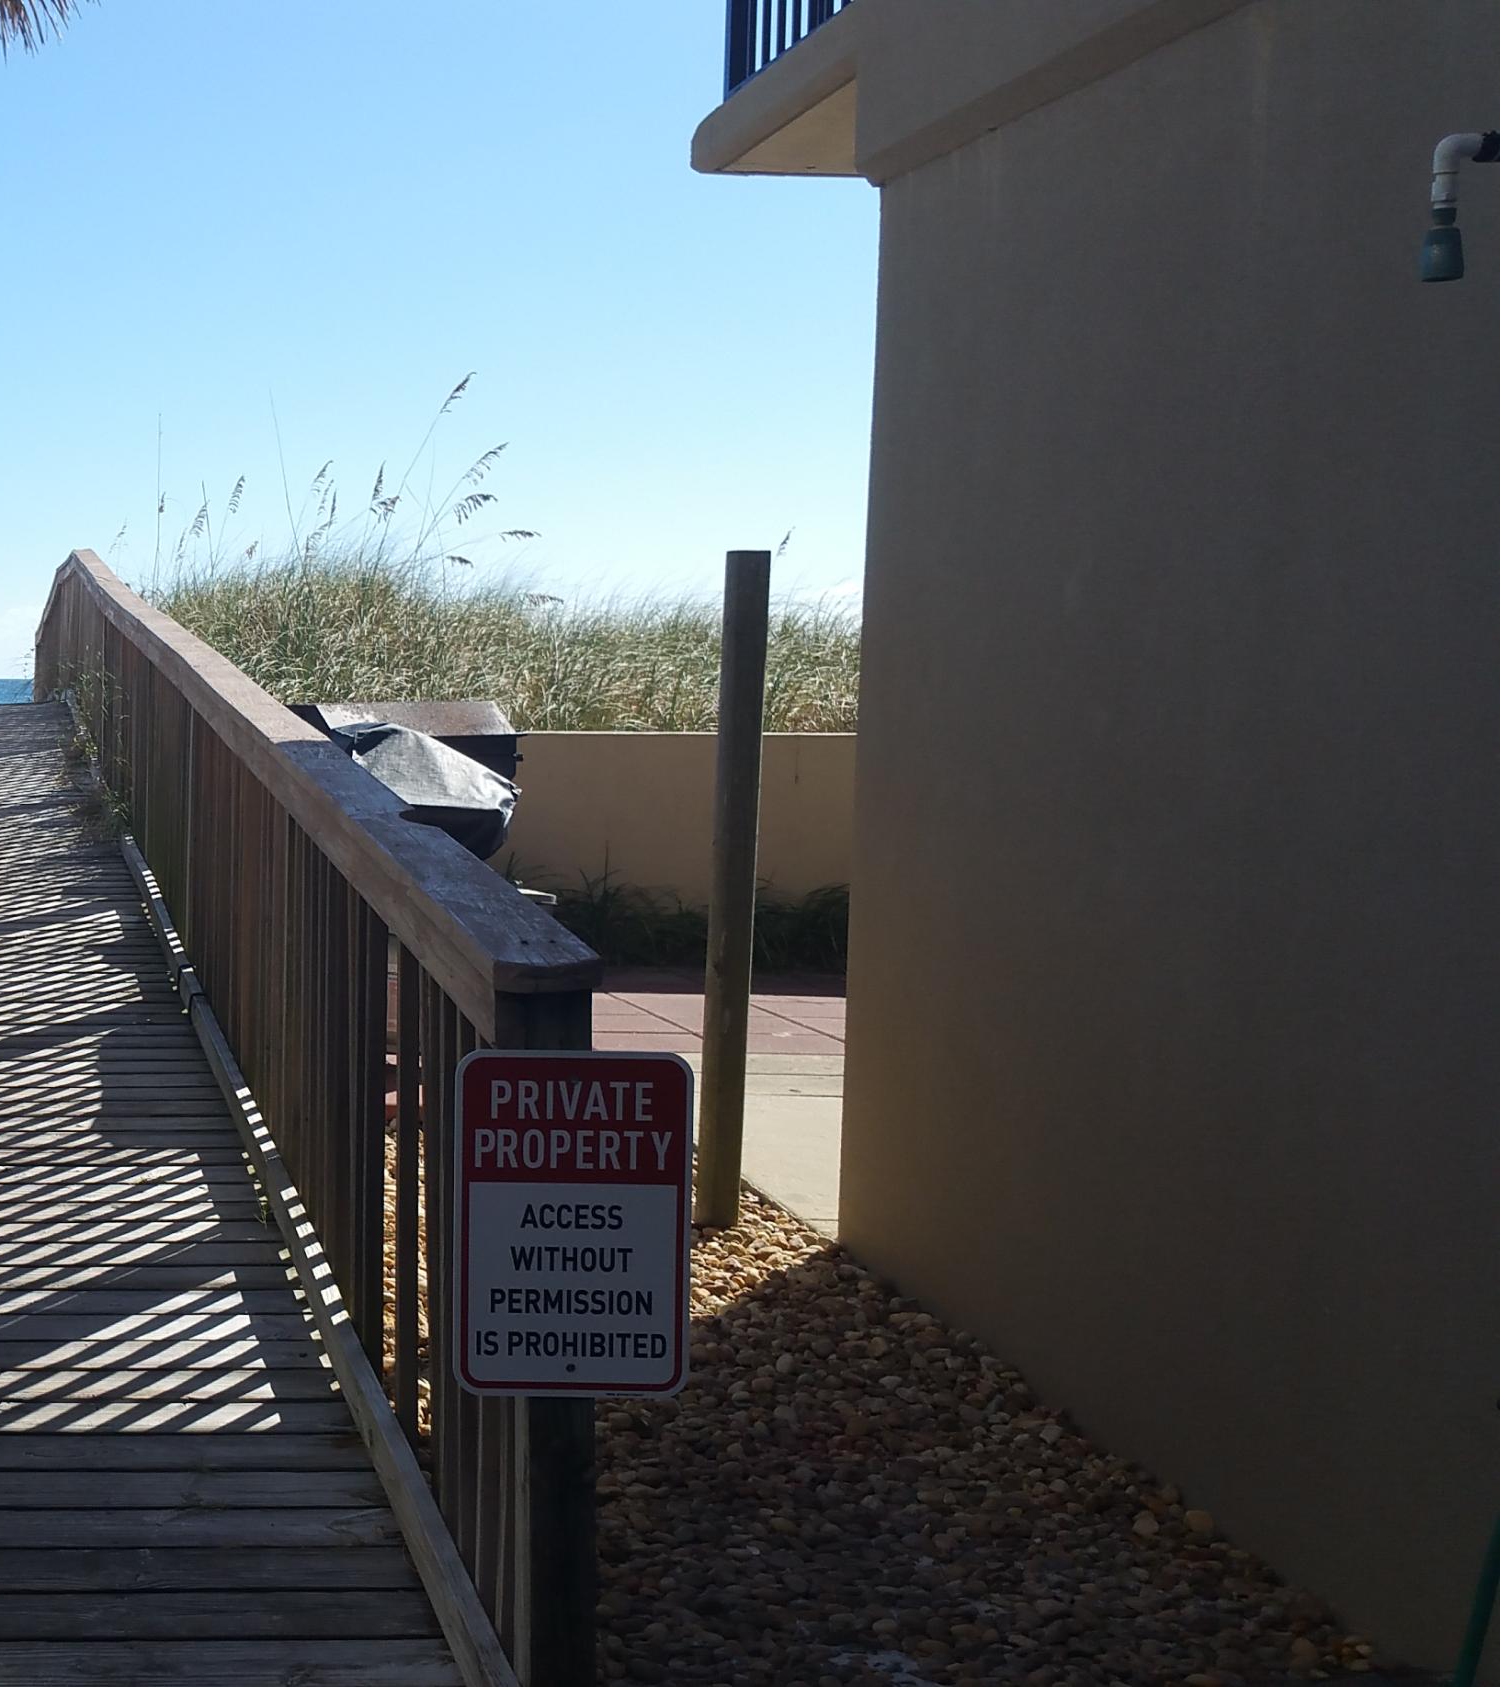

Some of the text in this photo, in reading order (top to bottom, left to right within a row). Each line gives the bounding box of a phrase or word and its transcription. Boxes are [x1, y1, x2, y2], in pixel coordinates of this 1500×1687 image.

[491, 1079, 654, 1122] PRIVATE
[474, 1128, 674, 1171] PROPERTY
[519, 1203, 624, 1231] ACCESS
[509, 1245, 634, 1274] WITHOUT
[489, 1288, 653, 1316] PERMISSION
[475, 1330, 668, 1360] IS PROHIBITED
